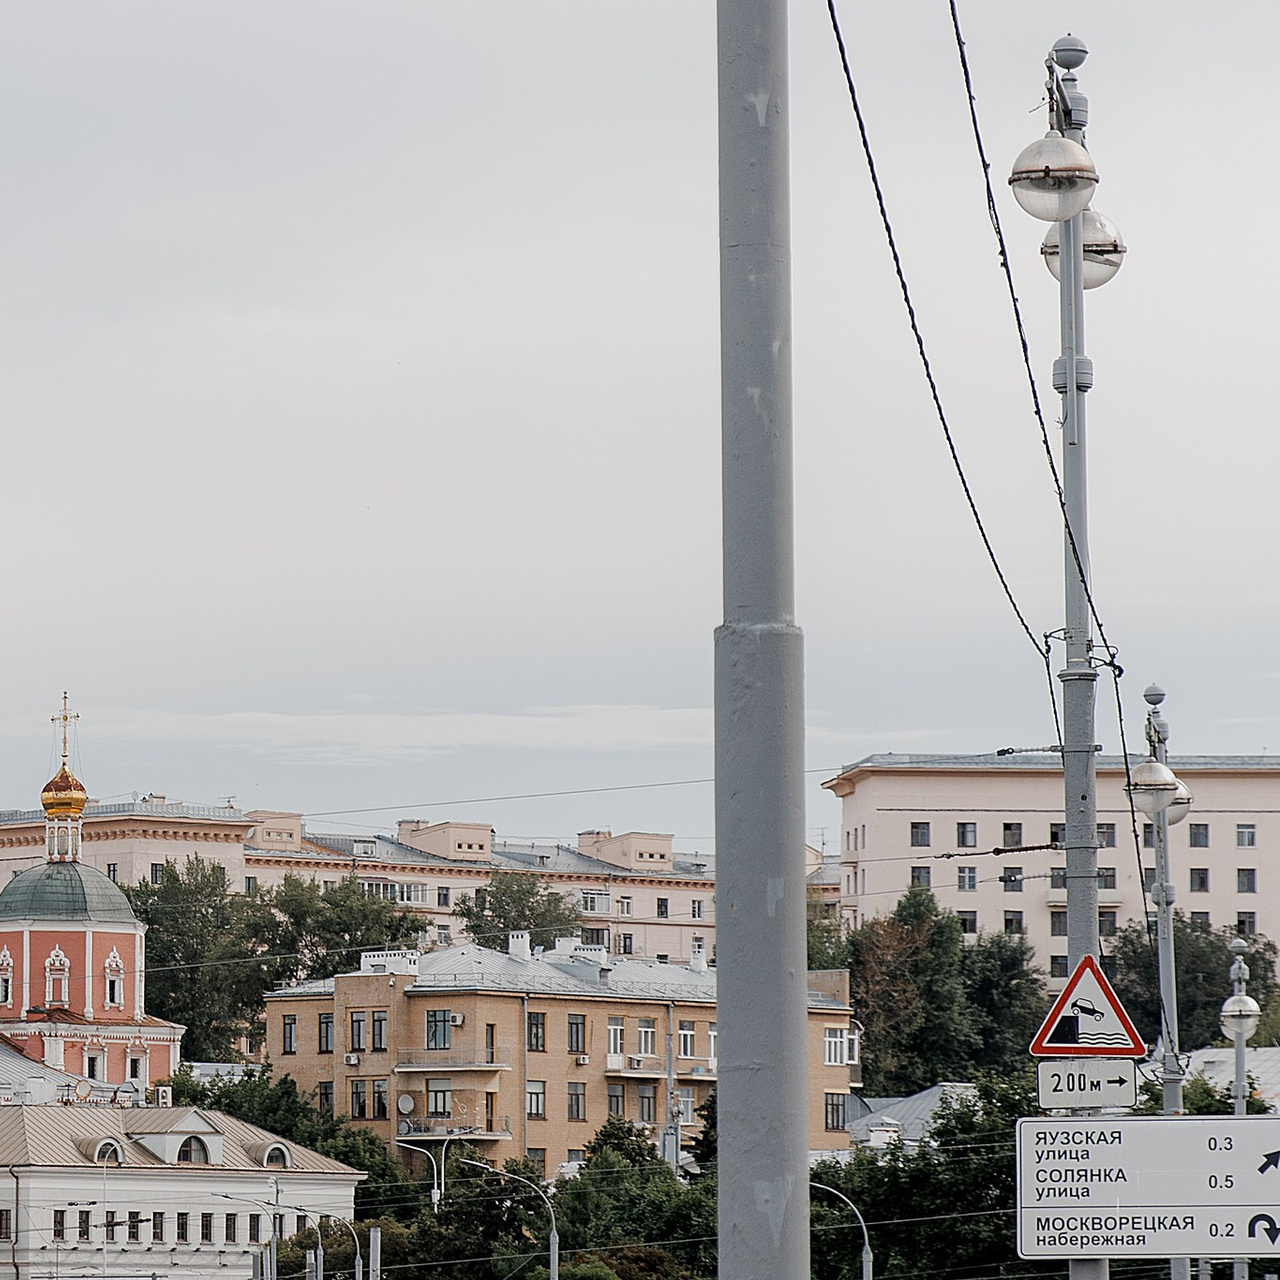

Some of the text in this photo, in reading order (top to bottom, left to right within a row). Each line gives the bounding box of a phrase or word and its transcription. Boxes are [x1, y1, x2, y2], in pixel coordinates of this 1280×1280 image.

[1035, 1130, 1122, 1146] ЯУЗСКАЯ
[1208, 1137, 1233, 1151] 0.3
[1035, 1149, 1090, 1164] улица
[1035, 1168, 1128, 1184] СОЛЯНКА
[1208, 1175, 1234, 1189] 0.5
[1036, 1186, 1090, 1202] улица
[1036, 1215, 1195, 1232] МОСКВОРЕЦКАЯ
[1209, 1222, 1235, 1238] 0.2
[1036, 1232, 1146, 1250] набережная
